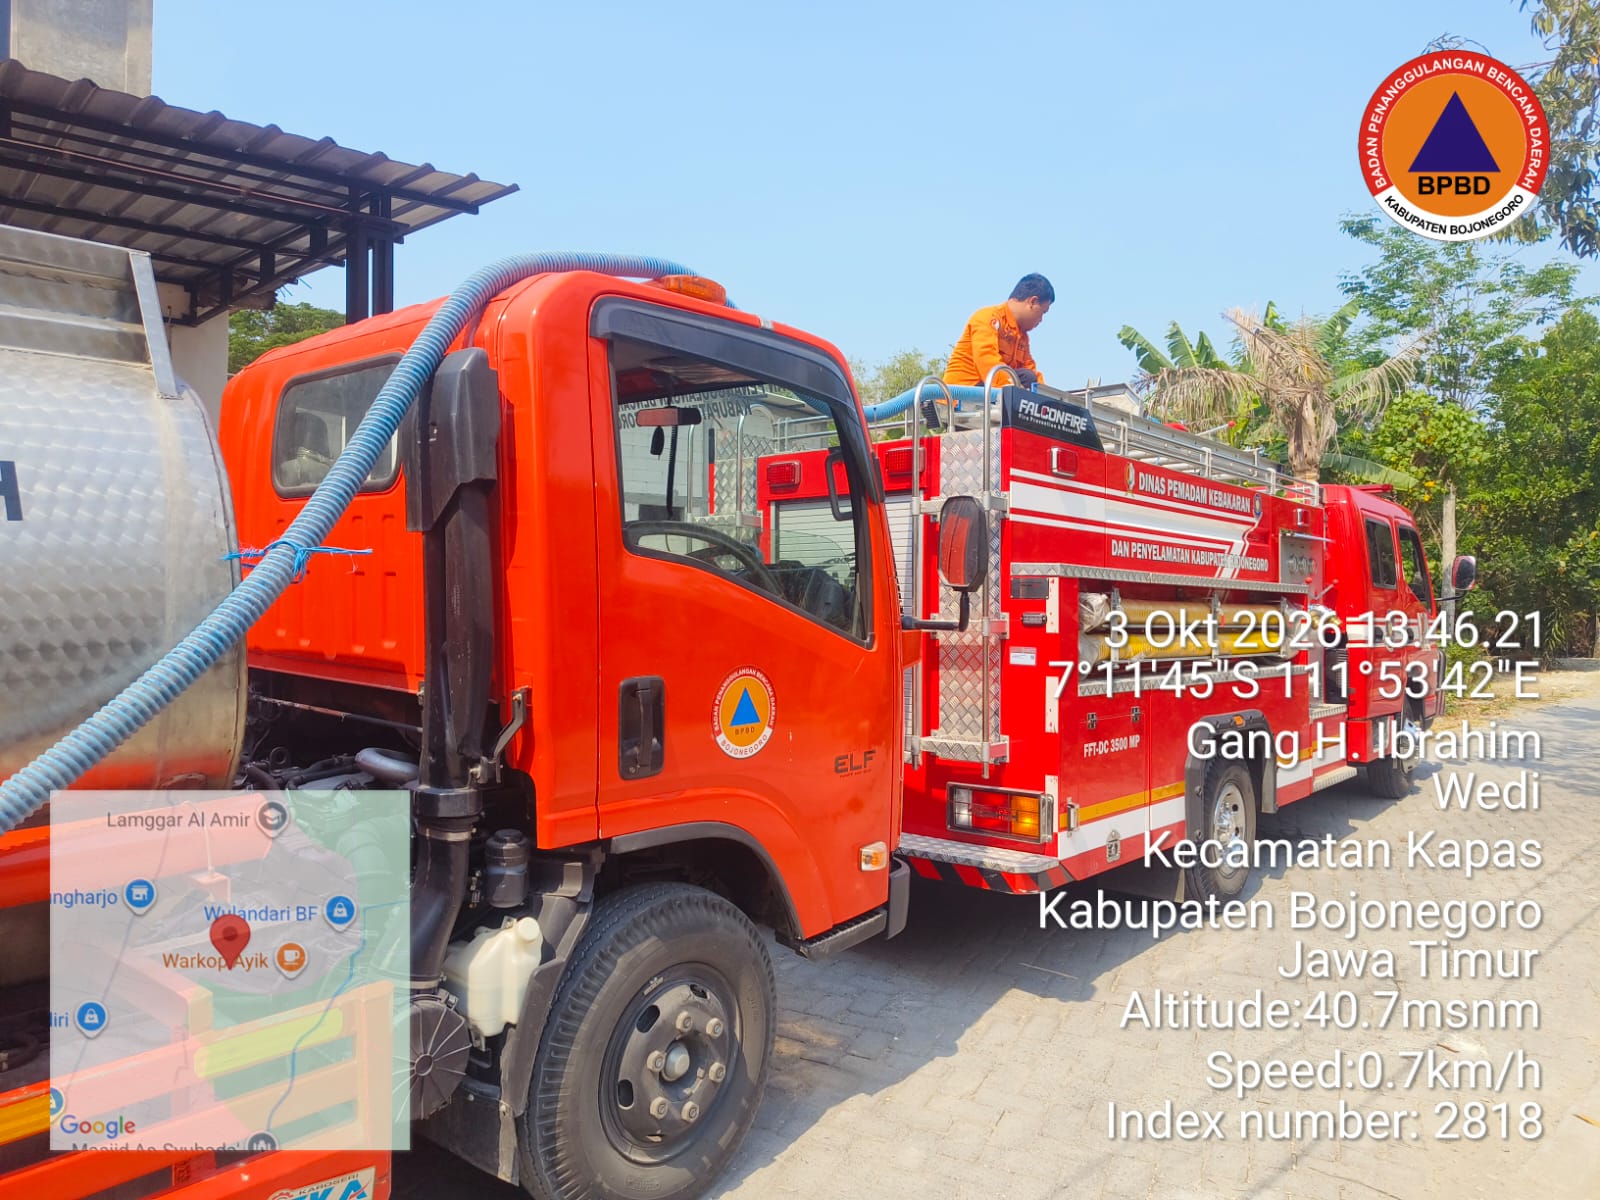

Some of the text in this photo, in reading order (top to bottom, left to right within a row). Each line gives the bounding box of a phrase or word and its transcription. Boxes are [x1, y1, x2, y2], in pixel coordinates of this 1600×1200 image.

[1018, 399, 1088, 433] FALCONFIRE
[1138, 472, 1251, 513] DINAS PEMADAM KEBAKARAN
[1111, 539, 1130, 557] DAN
[1131, 541, 1190, 564] PENYELAMATAN
[720, 733, 768, 757] BOJONEGORO
[1083, 734, 1141, 758] FFT-DC 3500 MP
[834, 749, 876, 774] ELF
